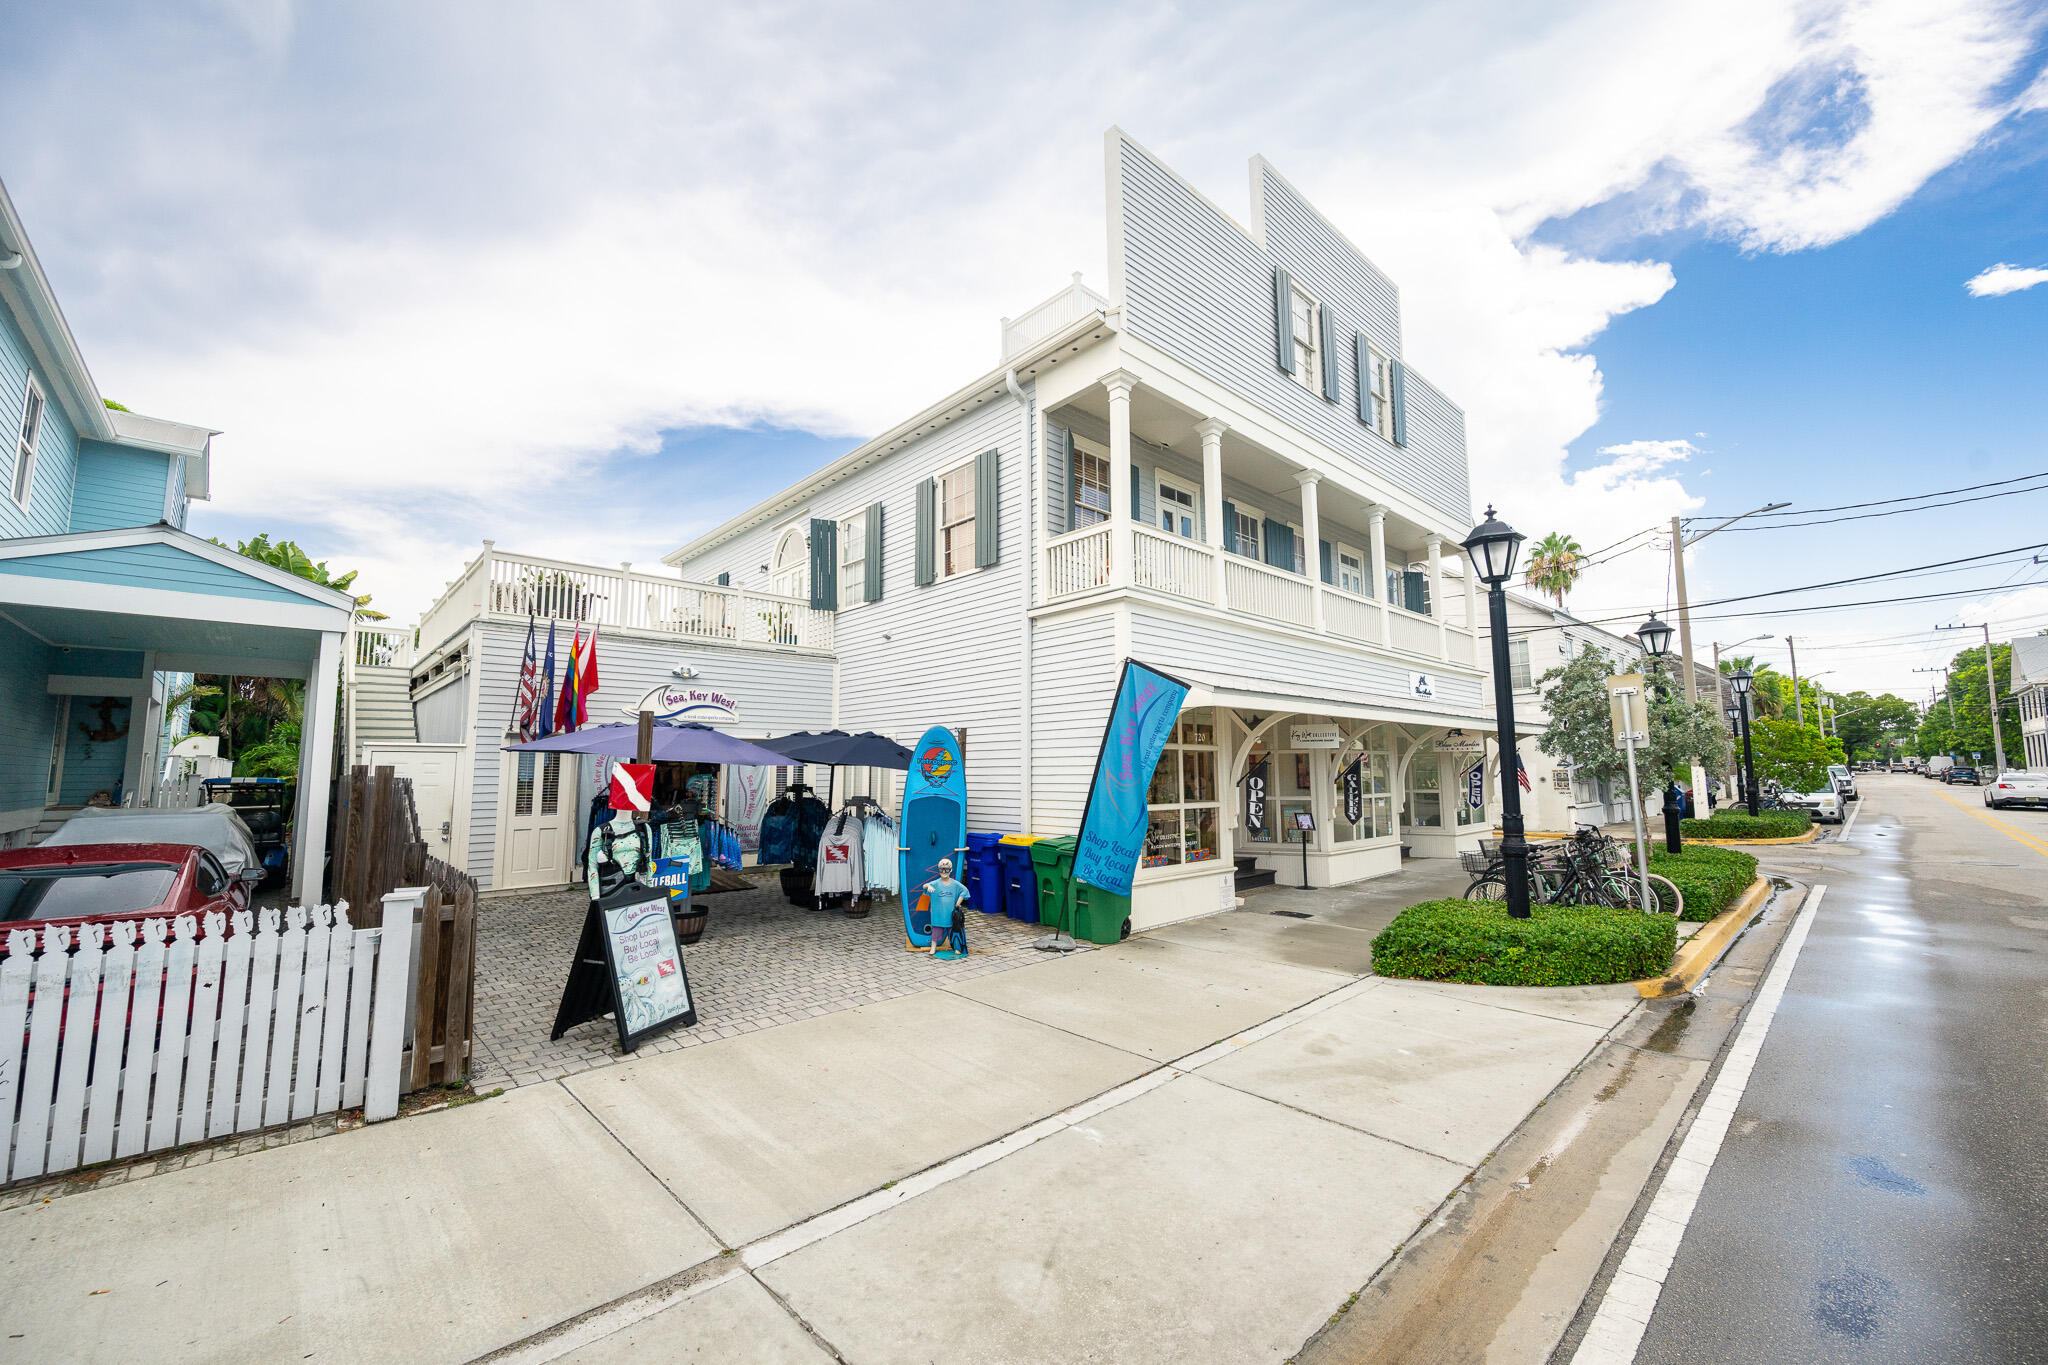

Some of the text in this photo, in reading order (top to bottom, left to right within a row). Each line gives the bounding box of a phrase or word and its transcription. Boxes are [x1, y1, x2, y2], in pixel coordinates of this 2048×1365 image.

[665, 690, 735, 709] Sea, Key West
[1163, 689, 1180, 718] company
[1119, 681, 1158, 780] Sea, Key West
[1346, 774, 1359, 820] GALLERY
[1469, 771, 1482, 805] OPEN
[1248, 777, 1264, 828] OPEN
[1085, 830, 1137, 859] Shop Local
[1084, 846, 1130, 874] Buy Local
[1083, 863, 1123, 887] Be Local
[639, 906, 650, 914] Key
[650, 904, 665, 913] West
[618, 926, 659, 945] Shop Local
[623, 938, 659, 954] Buy Local
[627, 948, 660, 964] Be Local
